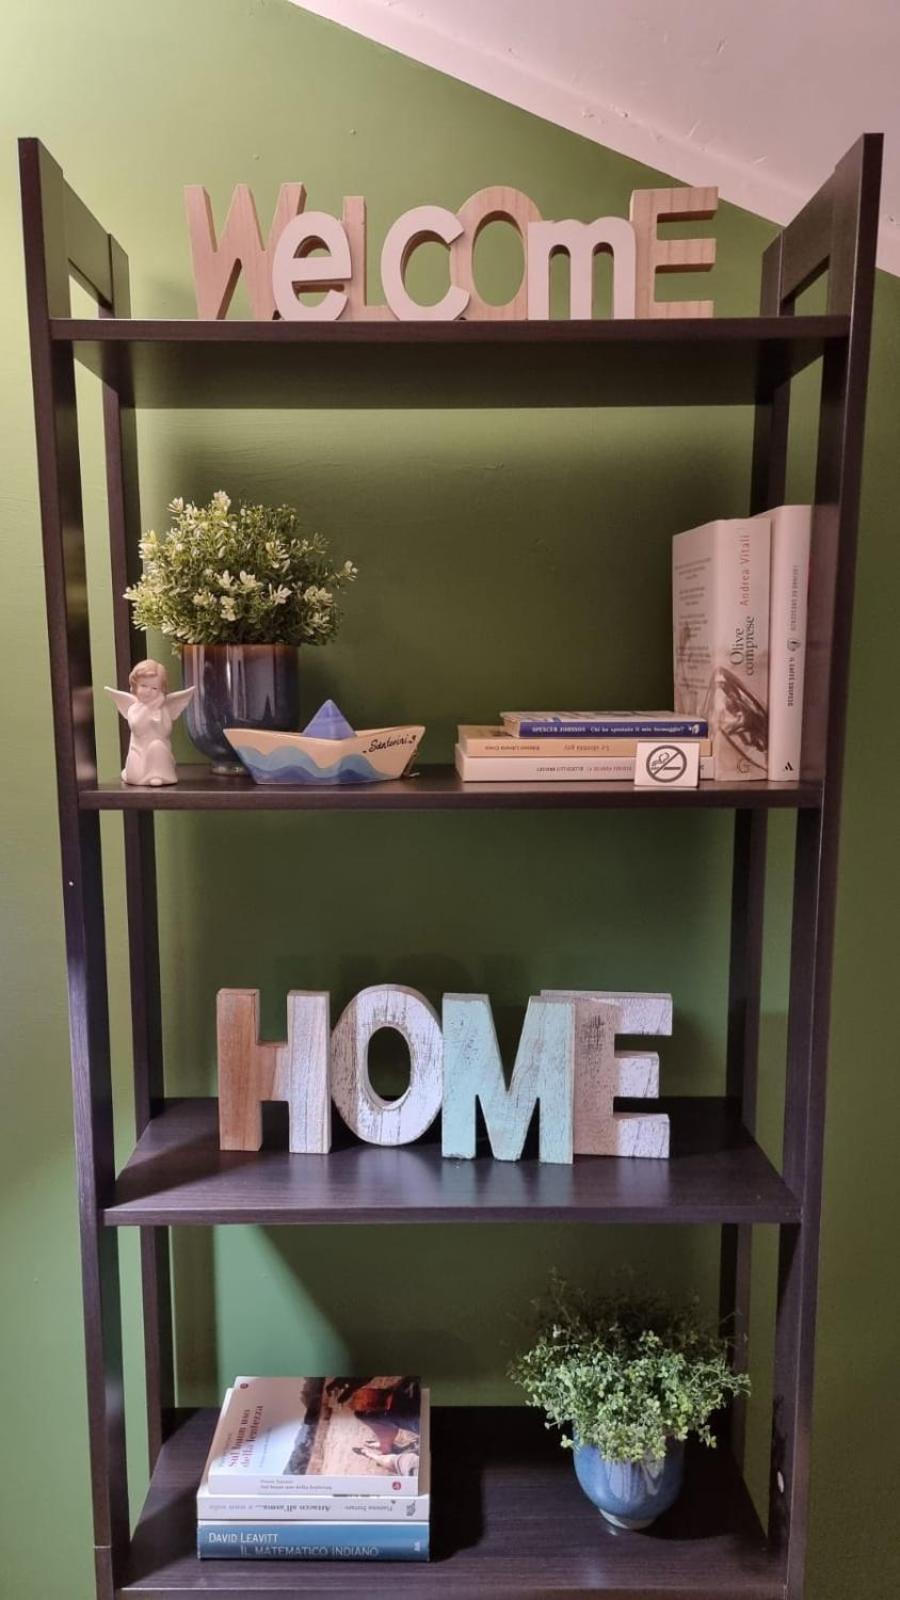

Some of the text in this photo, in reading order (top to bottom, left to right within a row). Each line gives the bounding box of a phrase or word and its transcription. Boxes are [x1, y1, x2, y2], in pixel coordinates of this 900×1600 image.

[739, 534, 750, 607] Andrea Vitali
[729, 628, 744, 666] Olive
[745, 616, 758, 676] comprese
[216, 983, 673, 1165] HOME
[299, 1504, 331, 1512] Attacco
[208, 1532, 279, 1544] DAVID LEAVITT
[240, 1546, 380, 1558] IL MATEMATICO INDIANO
